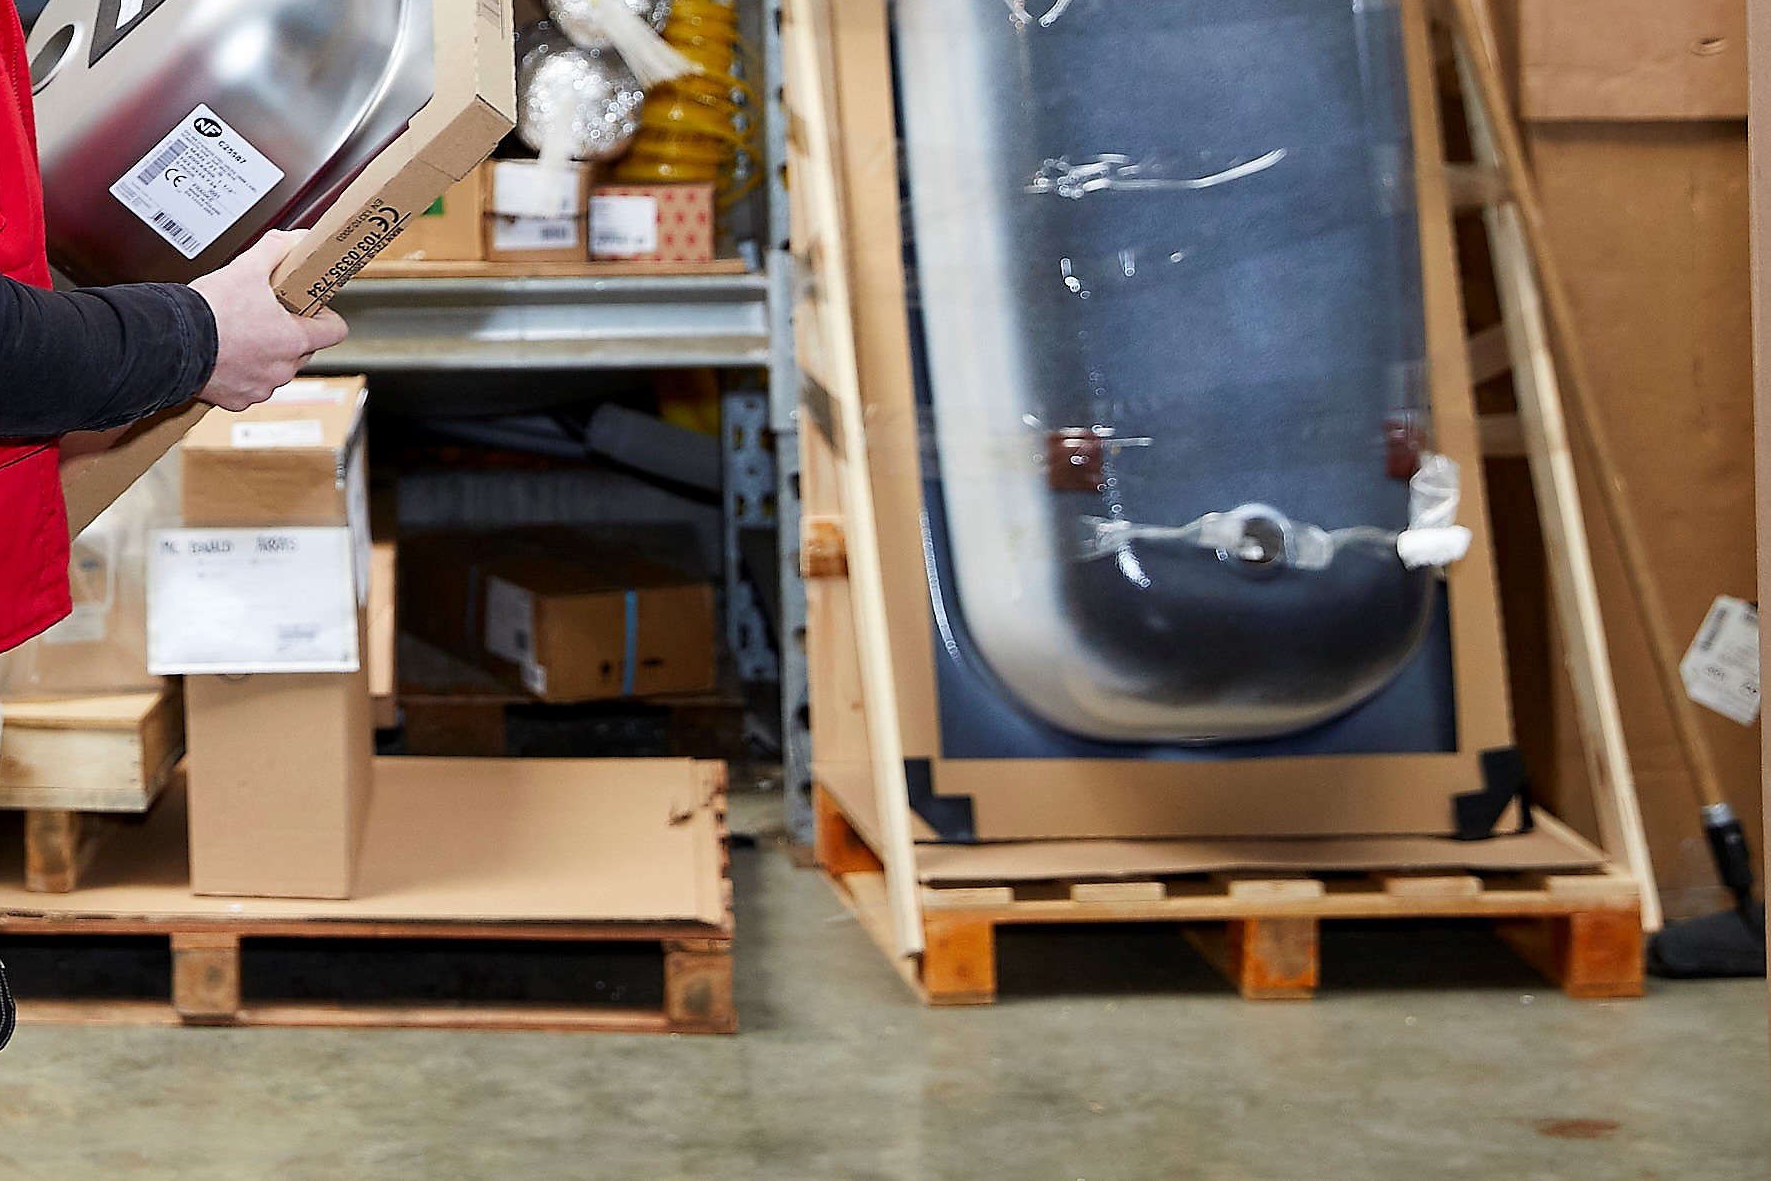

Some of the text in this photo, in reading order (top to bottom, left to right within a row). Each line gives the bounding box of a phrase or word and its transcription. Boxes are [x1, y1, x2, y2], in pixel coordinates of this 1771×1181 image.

[195, 118, 221, 138] NF
[370, 197, 382, 209] EN
[305, 228, 381, 300] 103.0335.734
